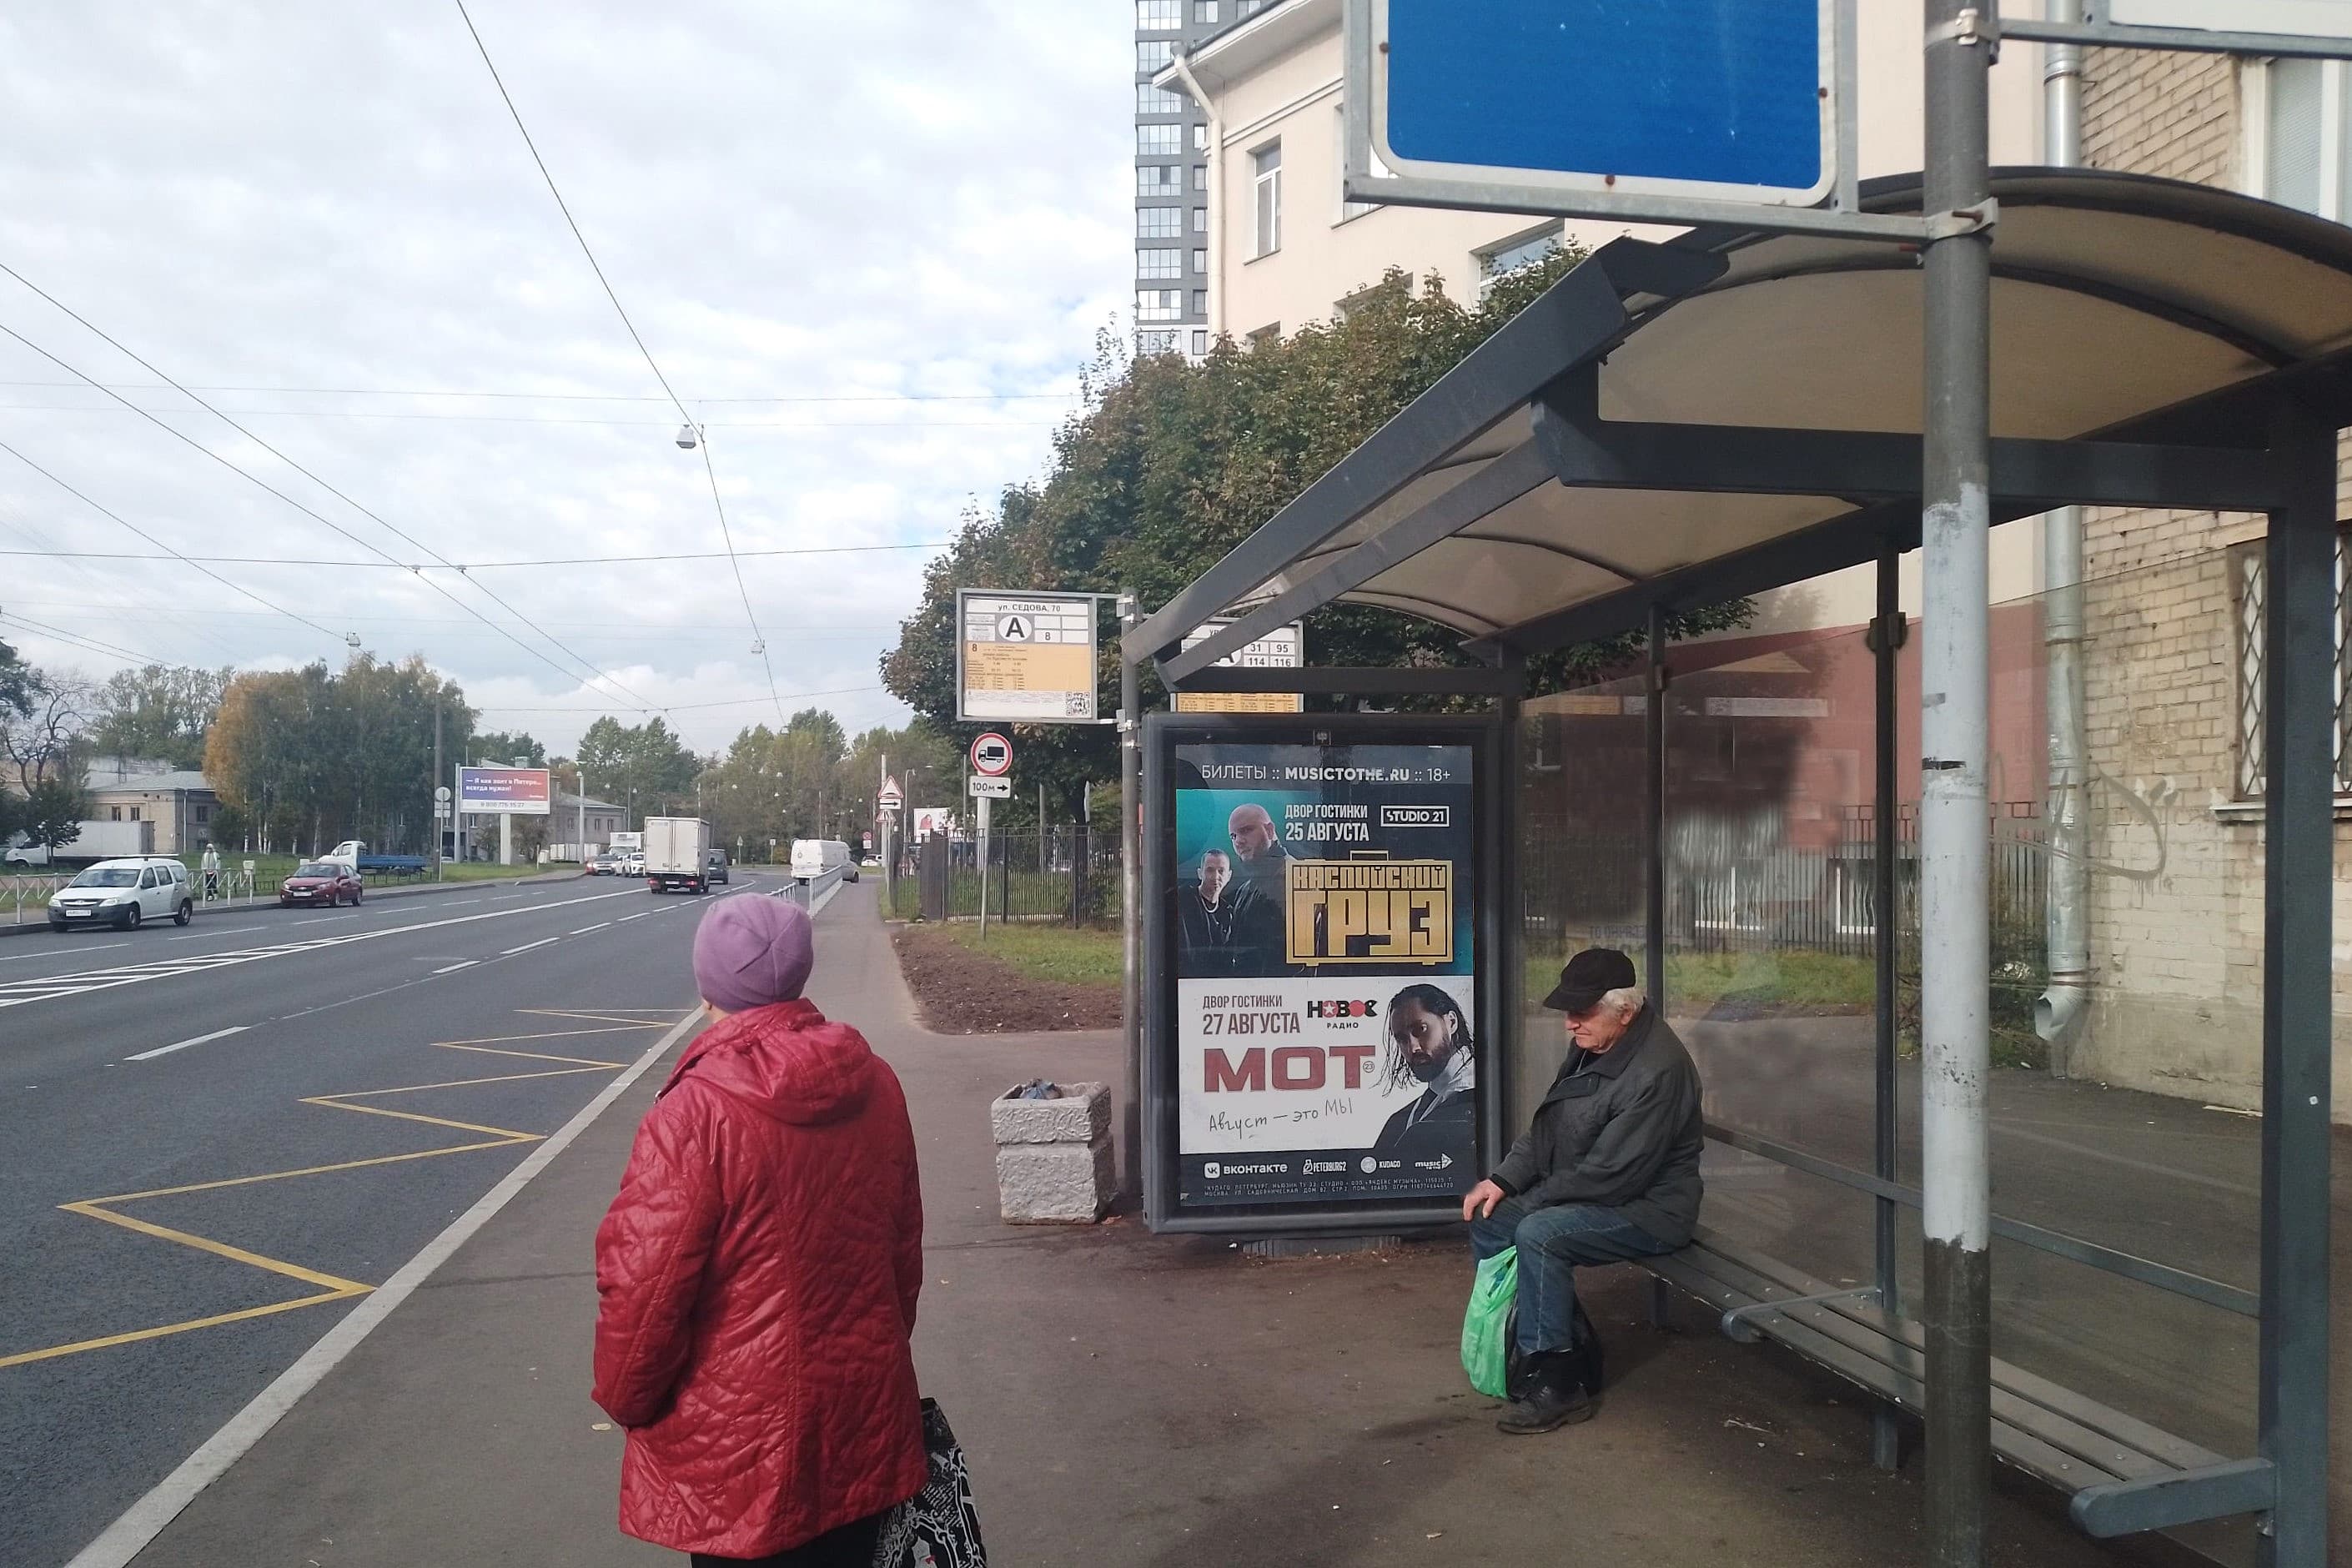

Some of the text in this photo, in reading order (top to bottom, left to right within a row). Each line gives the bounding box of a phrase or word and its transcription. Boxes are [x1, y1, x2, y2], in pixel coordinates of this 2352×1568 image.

[1012, 604, 1049, 612] СЕДОВА,
[1005, 616, 1025, 638] А
[1044, 631, 1052, 641] 8
[972, 643, 977, 652] 8
[1250, 643, 1289, 653] 31 95
[1249, 657, 1292, 667] 114 116
[1201, 765, 1266, 779] БИЛЕТЫ
[1284, 766, 1410, 781] MUSICTOTHE.RU
[1426, 767, 1451, 781] 18+
[1284, 804, 1368, 820] ДВОР ГОСТИНКИ
[1386, 810, 1444, 822] STUDIO 21
[1285, 822, 1369, 842] 25 АВГУСТА
[1294, 866, 1446, 889] КАСПИЙСКИЙ
[1294, 890, 1446, 956] ГРУЗ
[1203, 995, 1283, 1009] ДВОР ГОСТИНКИ
[1203, 1013, 1300, 1035] 27 АВГУСТА
[1204, 1045, 1376, 1093] МОТ
[1209, 1111, 1267, 1139] Август
[1292, 1109, 1319, 1123] это
